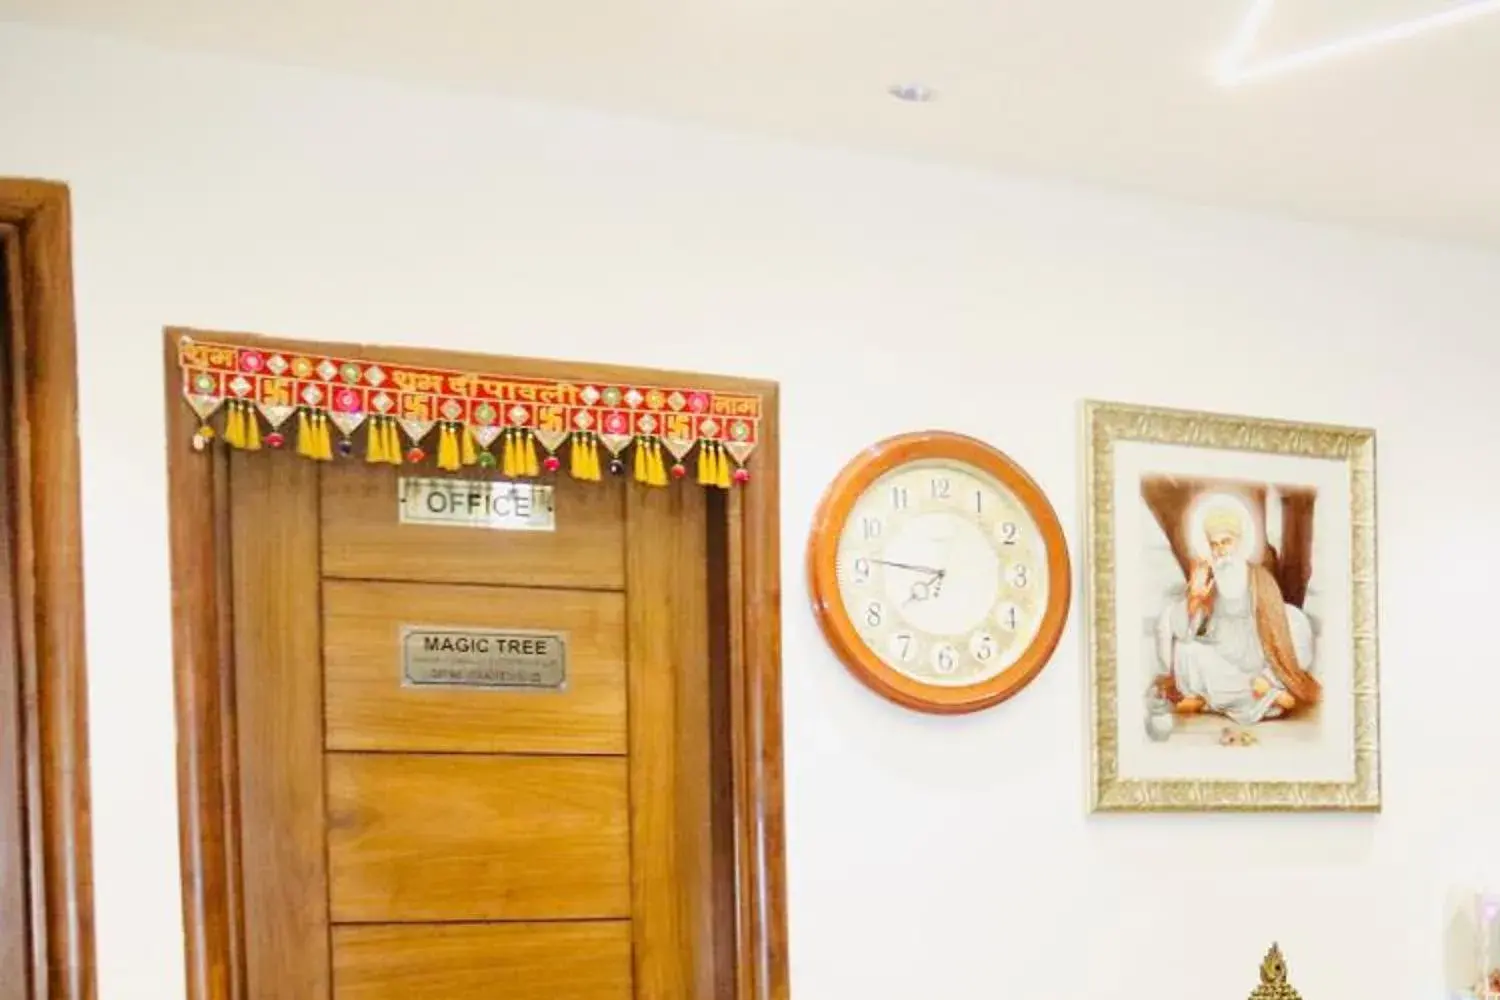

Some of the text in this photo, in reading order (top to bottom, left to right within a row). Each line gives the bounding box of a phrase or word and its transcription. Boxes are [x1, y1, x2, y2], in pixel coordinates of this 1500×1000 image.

[892, 486, 908, 511] 11
[930, 478, 950, 499] 12
[426, 490, 530, 518] OFFICE
[974, 490, 983, 513] 1
[862, 517, 882, 540] 10
[1001, 522, 1017, 546] 2
[854, 557, 870, 583] 9
[1012, 564, 1028, 588] 3
[866, 603, 882, 627] 8
[1004, 606, 1017, 630] 4
[423, 636, 548, 656] MAGIC TREE
[896, 634, 911, 660] 7
[937, 645, 953, 671] 6
[976, 636, 992, 661] 5
